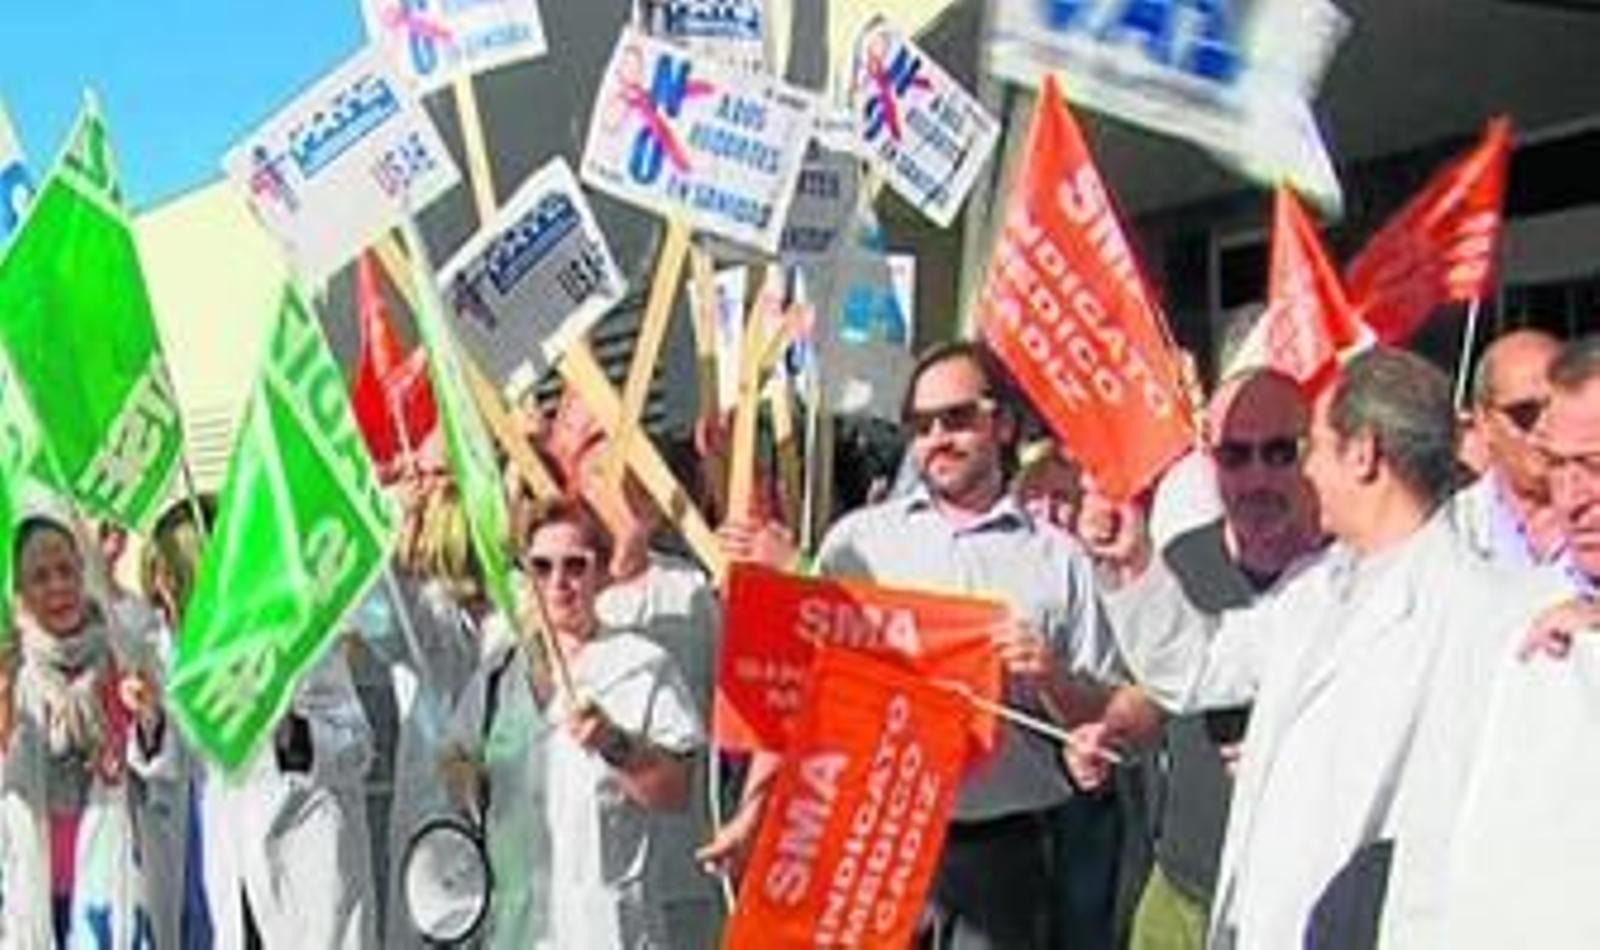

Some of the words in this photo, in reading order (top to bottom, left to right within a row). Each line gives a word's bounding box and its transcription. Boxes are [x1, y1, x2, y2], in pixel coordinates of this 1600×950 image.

[797, 597, 923, 659] SMA
[763, 752, 849, 904] SMA
[874, 770, 941, 936] CADIZ
